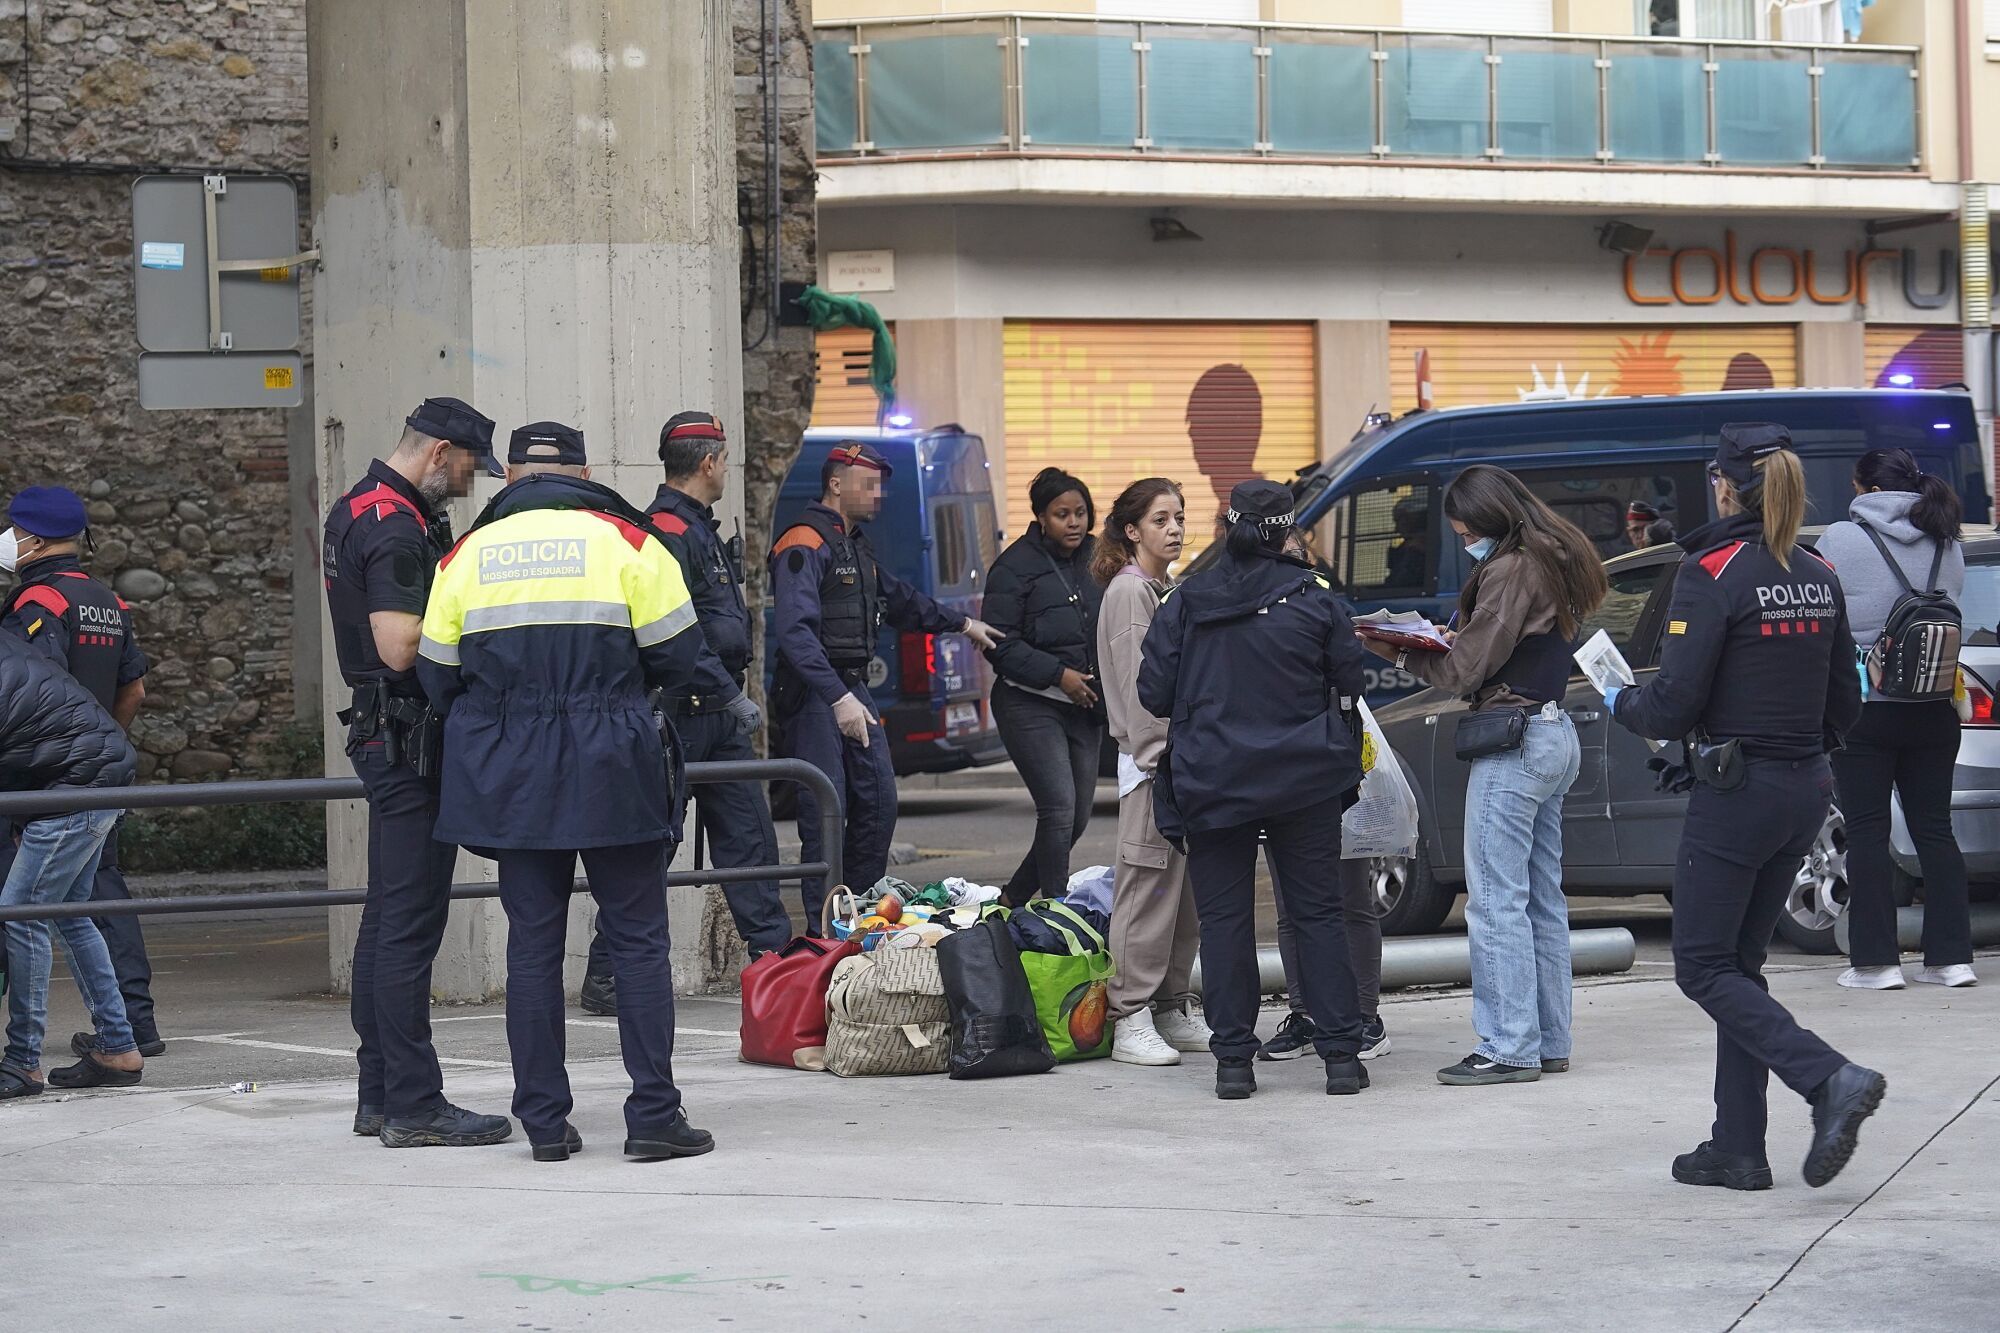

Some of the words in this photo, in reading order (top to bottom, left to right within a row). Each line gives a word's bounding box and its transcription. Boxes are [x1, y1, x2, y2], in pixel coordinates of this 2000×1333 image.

[482, 541, 581, 568] POLICIA
[482, 569, 521, 582] MOSSOS
[1756, 583, 1834, 607] POLICIA
[79, 605, 122, 626] POLICIA
[1762, 609, 1796, 620] mossos
